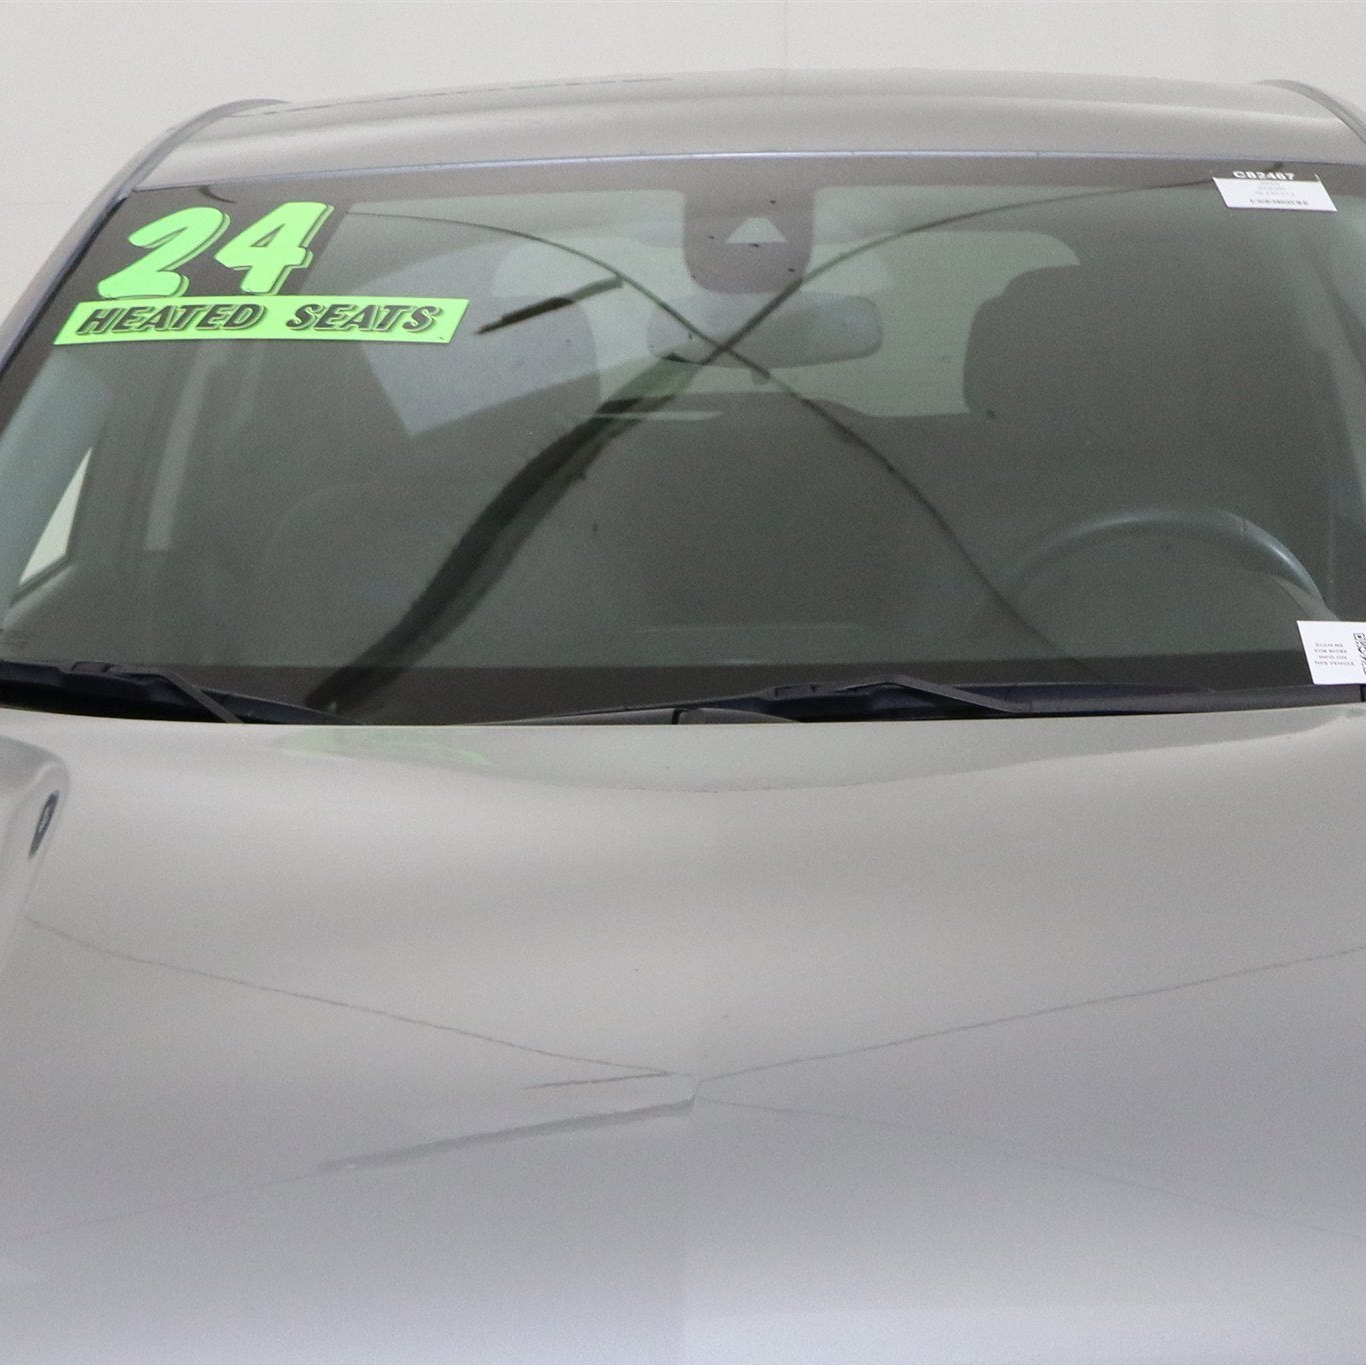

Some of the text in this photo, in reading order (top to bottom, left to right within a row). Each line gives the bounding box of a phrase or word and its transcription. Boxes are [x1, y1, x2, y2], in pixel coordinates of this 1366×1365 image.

[96, 201, 335, 300] 24
[75, 303, 444, 335] HEATED SEATS
